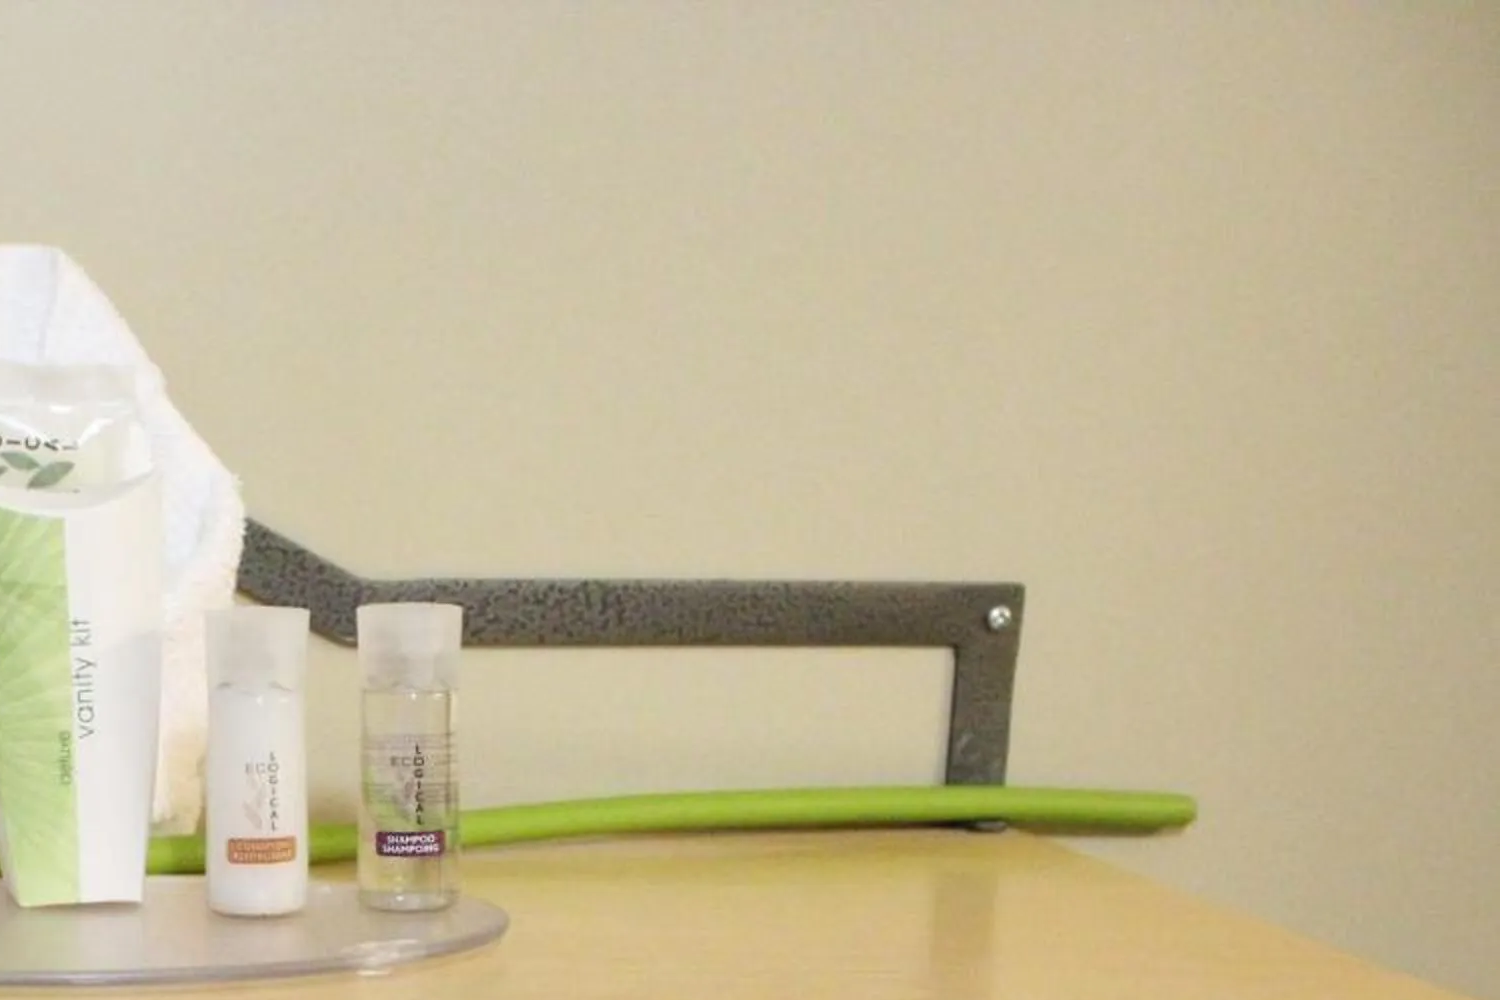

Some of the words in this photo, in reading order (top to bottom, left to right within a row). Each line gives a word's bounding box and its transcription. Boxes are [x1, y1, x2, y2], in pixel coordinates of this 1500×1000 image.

[69, 618, 92, 647] kit
[72, 656, 97, 740] vanity
[267, 750, 280, 832] LOGICAL
[413, 742, 426, 826] LOGICAL
[387, 834, 436, 844] SHAMPOO
